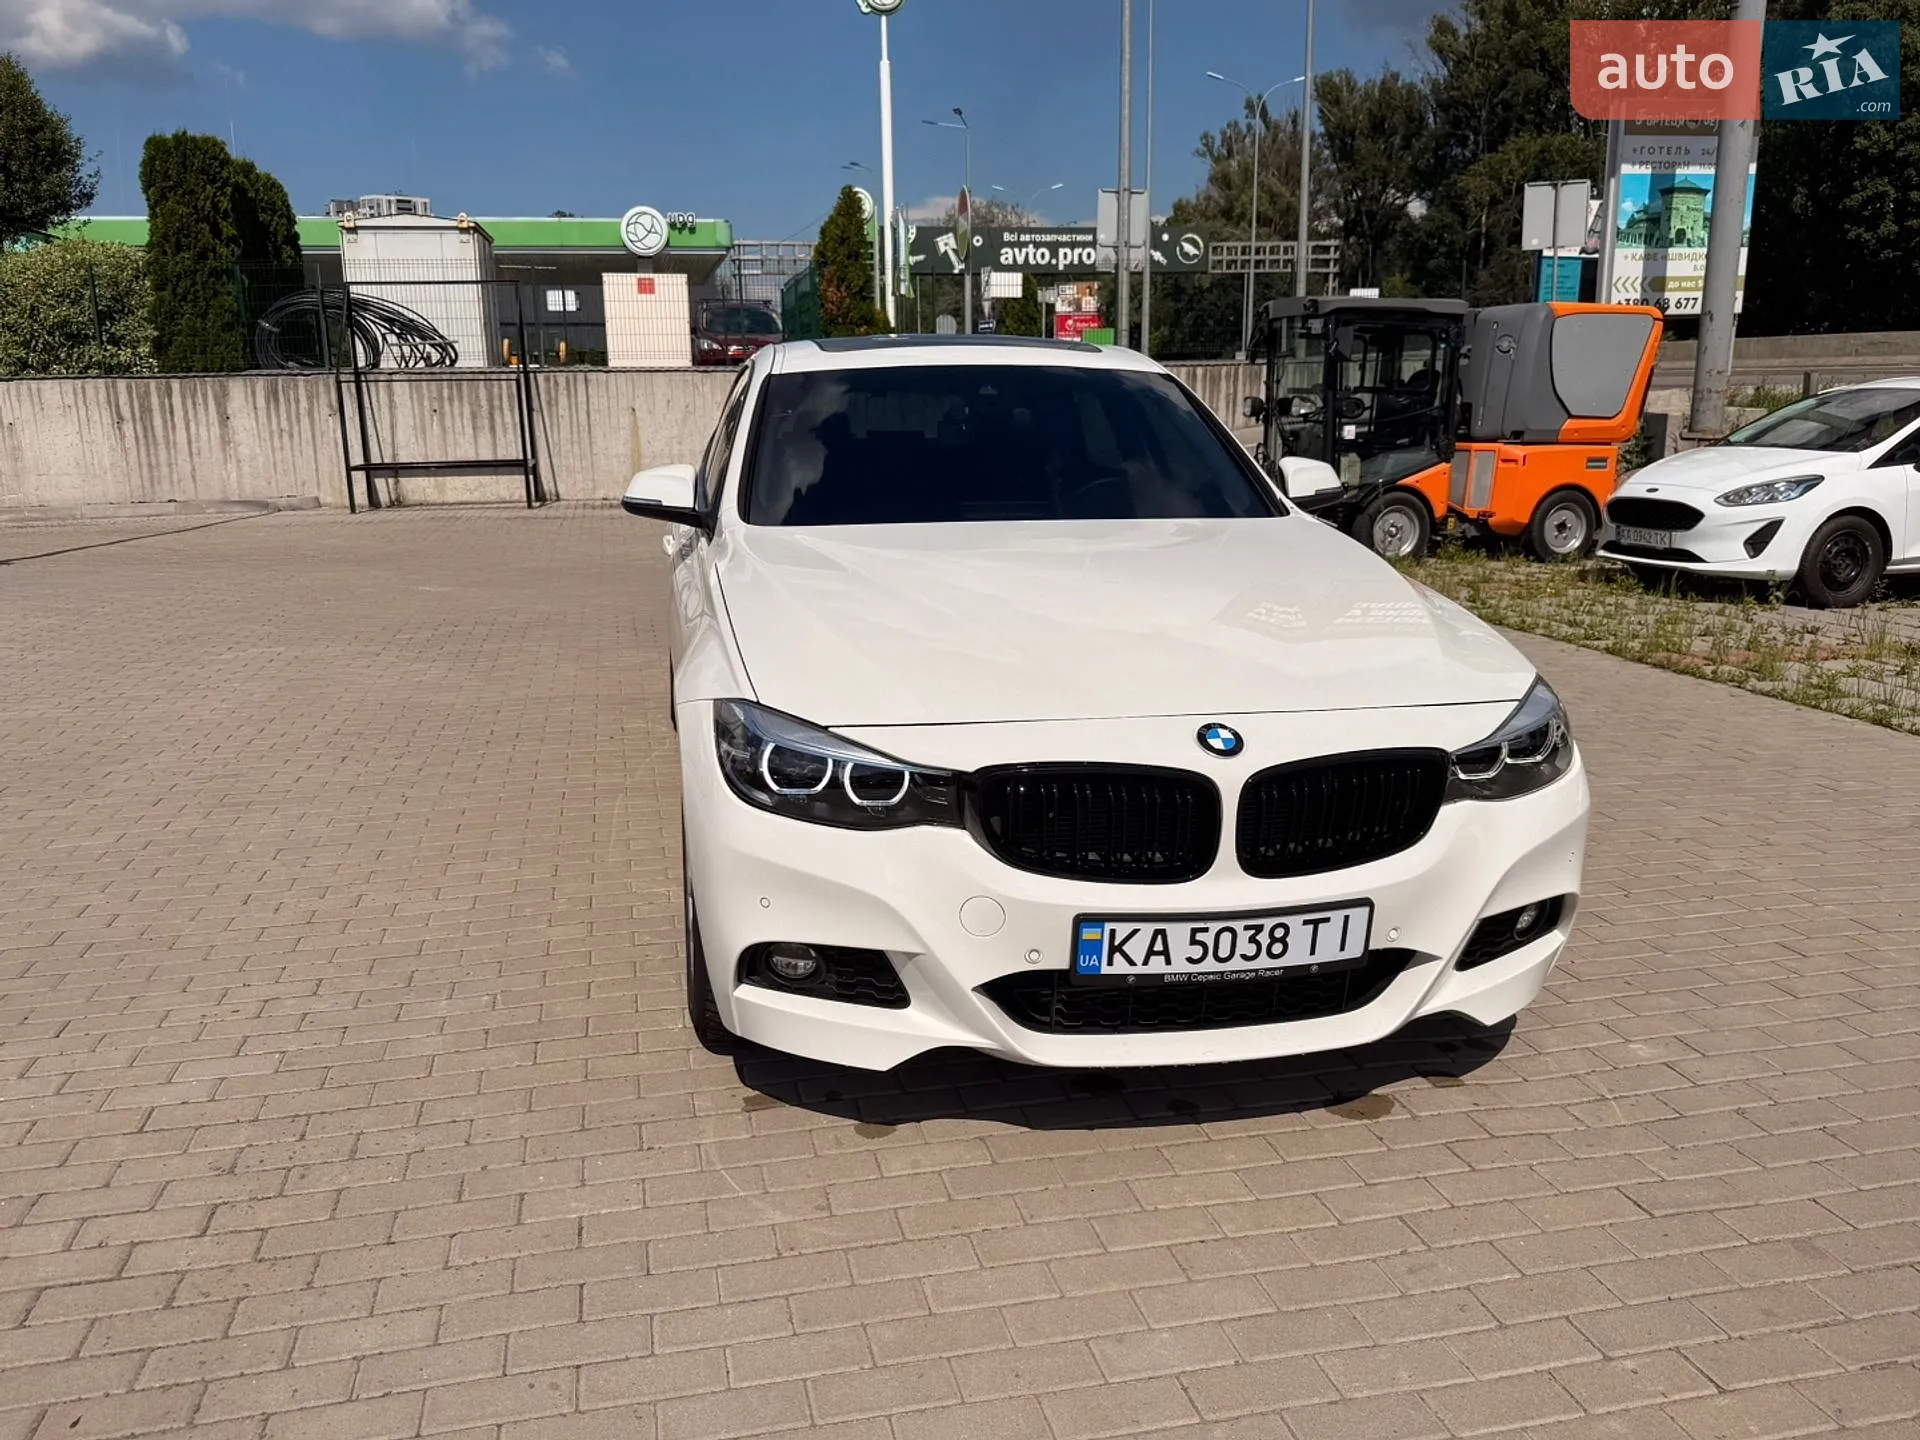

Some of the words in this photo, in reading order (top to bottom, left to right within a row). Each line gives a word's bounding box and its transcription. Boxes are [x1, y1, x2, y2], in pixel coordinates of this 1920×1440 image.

[1640, 145, 1690, 156] ГОТЕЛЬ
[1638, 160, 1690, 170] РЕСТОРАН
[1003, 232, 1018, 241] Всі
[1019, 233, 1093, 242] автозапчастини
[1000, 244, 1097, 270] avto.pro
[1630, 252, 1659, 262] КАФЕ
[1654, 296, 1671, 309] 68
[1675, 297, 1699, 309] 677
[1106, 927, 1172, 967] KA
[1184, 922, 1290, 965] 5038
[1302, 914, 1350, 956] TI
[1079, 955, 1100, 967] UA
[1164, 973, 1189, 982] BMW
[1223, 971, 1256, 980] Garage
